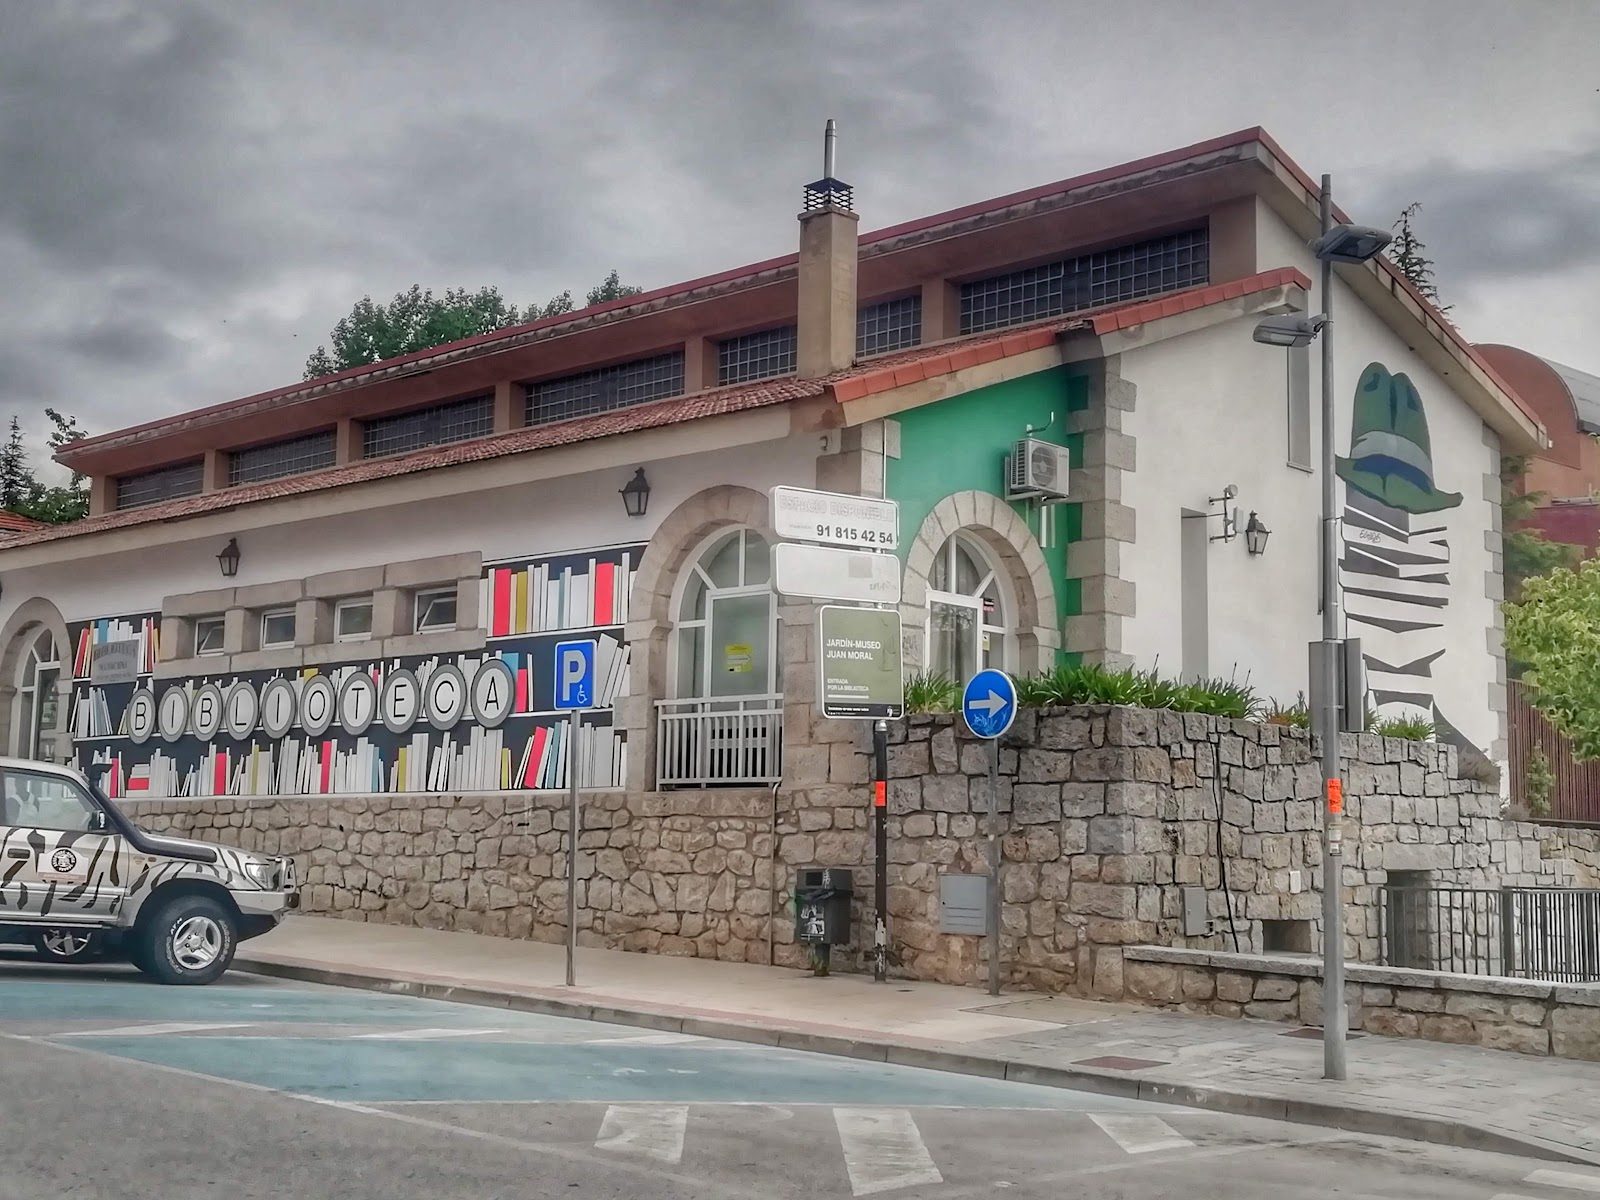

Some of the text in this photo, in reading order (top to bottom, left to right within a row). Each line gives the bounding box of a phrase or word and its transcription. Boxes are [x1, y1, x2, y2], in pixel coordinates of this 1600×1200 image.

[816, 524, 831, 537] 91
[835, 526, 858, 540] 815
[861, 530, 876, 542] 42
[879, 532, 893, 544] 54
[826, 638, 881, 650] JARDÍN-MUSEO
[826, 650, 873, 660] JUAN MORAL
[562, 649, 587, 701] P
[134, 675, 500, 731] BIBLIOTECA
